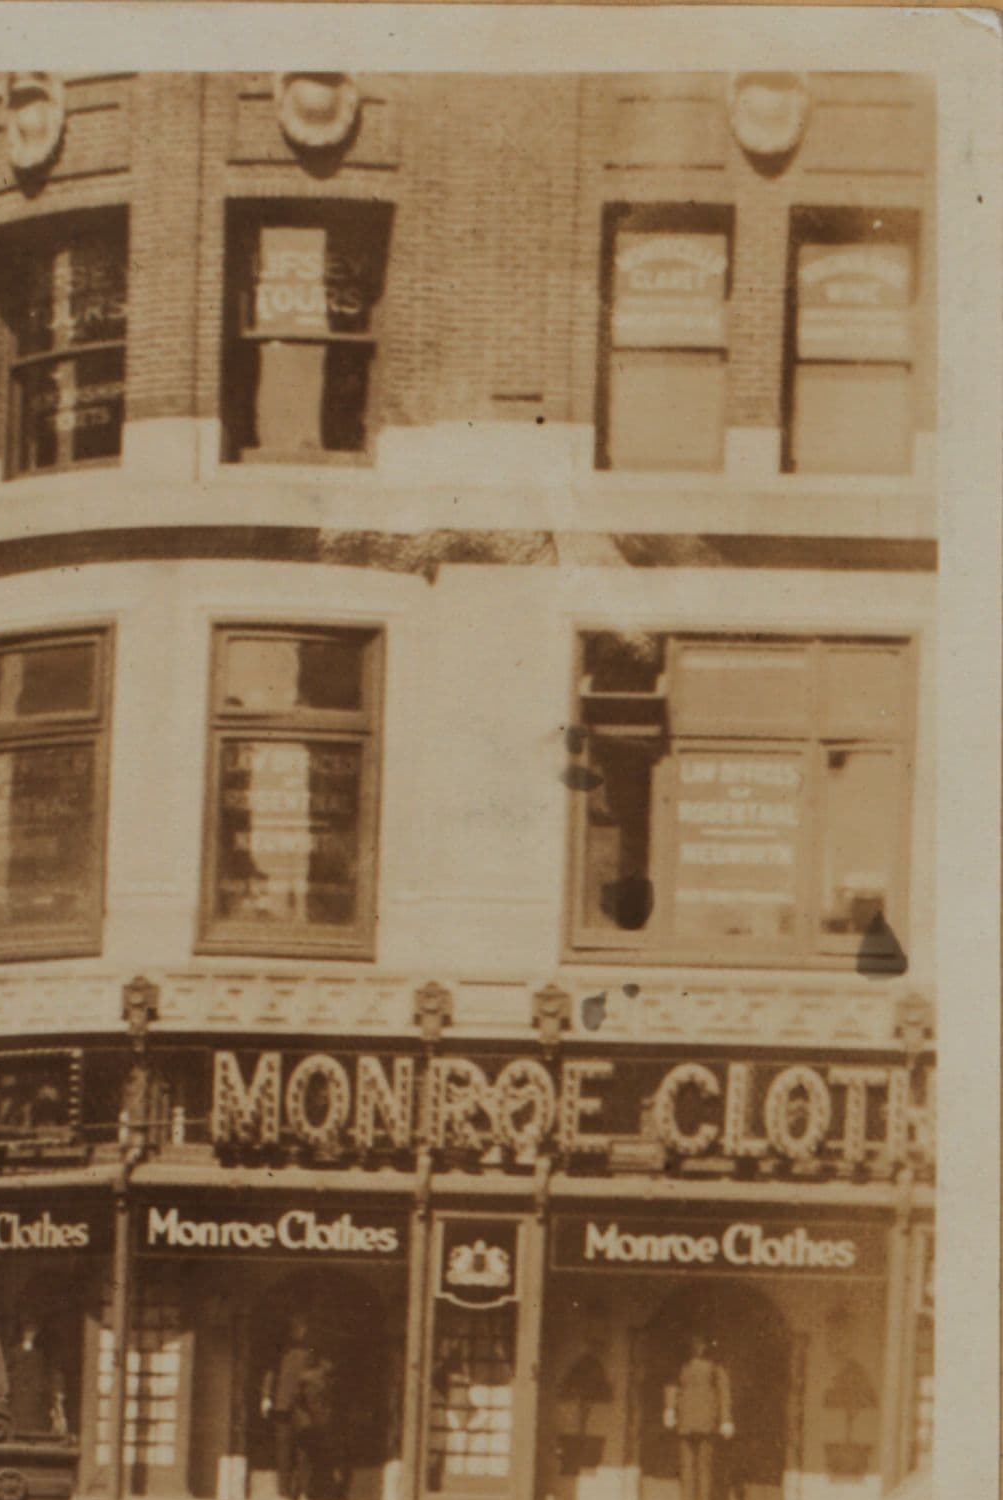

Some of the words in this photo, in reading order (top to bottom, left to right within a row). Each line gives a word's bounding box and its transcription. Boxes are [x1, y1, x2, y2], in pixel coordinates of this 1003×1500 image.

[211, 1051, 615, 1154] MONROE
[148, 1207, 277, 1248] Monroe
[277, 1210, 399, 1252] Clothes
[584, 1222, 720, 1263] Monroe
[721, 1222, 856, 1267] Clothes
